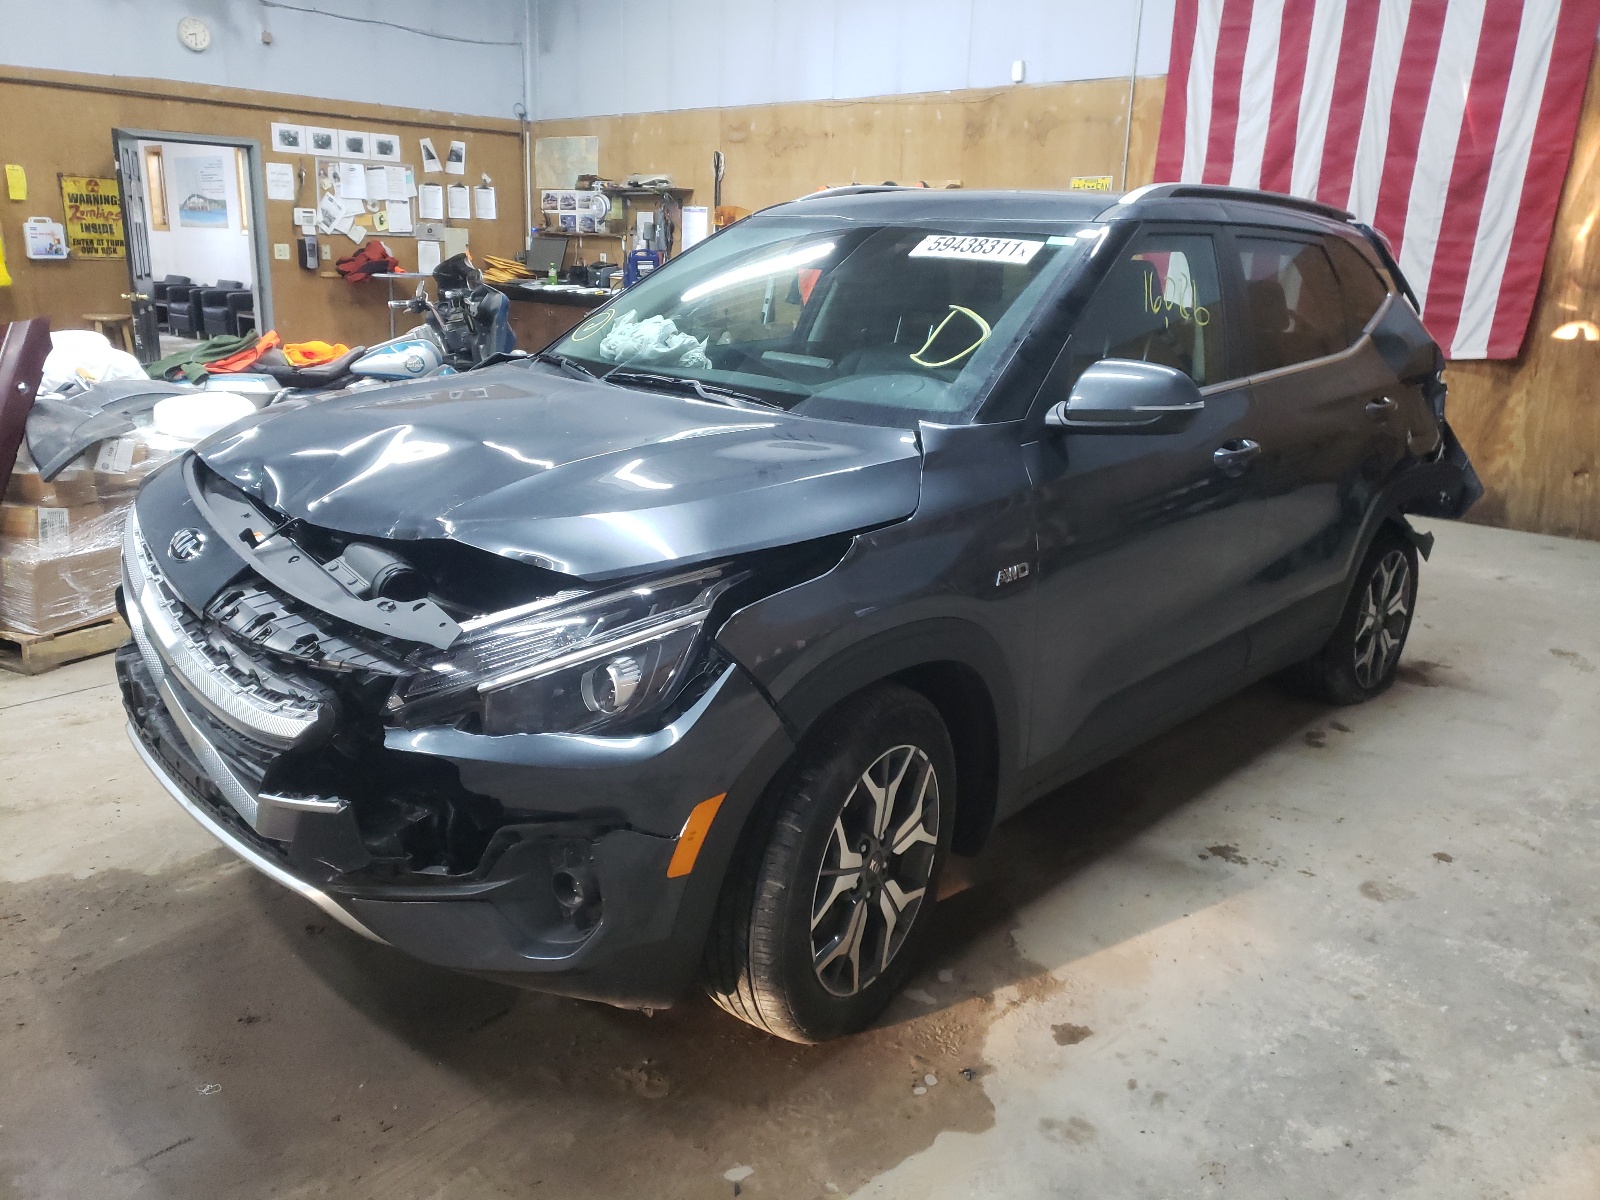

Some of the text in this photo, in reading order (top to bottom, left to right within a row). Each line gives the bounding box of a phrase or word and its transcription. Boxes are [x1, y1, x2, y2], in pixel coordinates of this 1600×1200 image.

[80, 223, 115, 235] INSIDE
[72, 238, 125, 247] ENTER AT YOUR
[101, 247, 118, 255] RISK
[995, 561, 1030, 587] AWD
